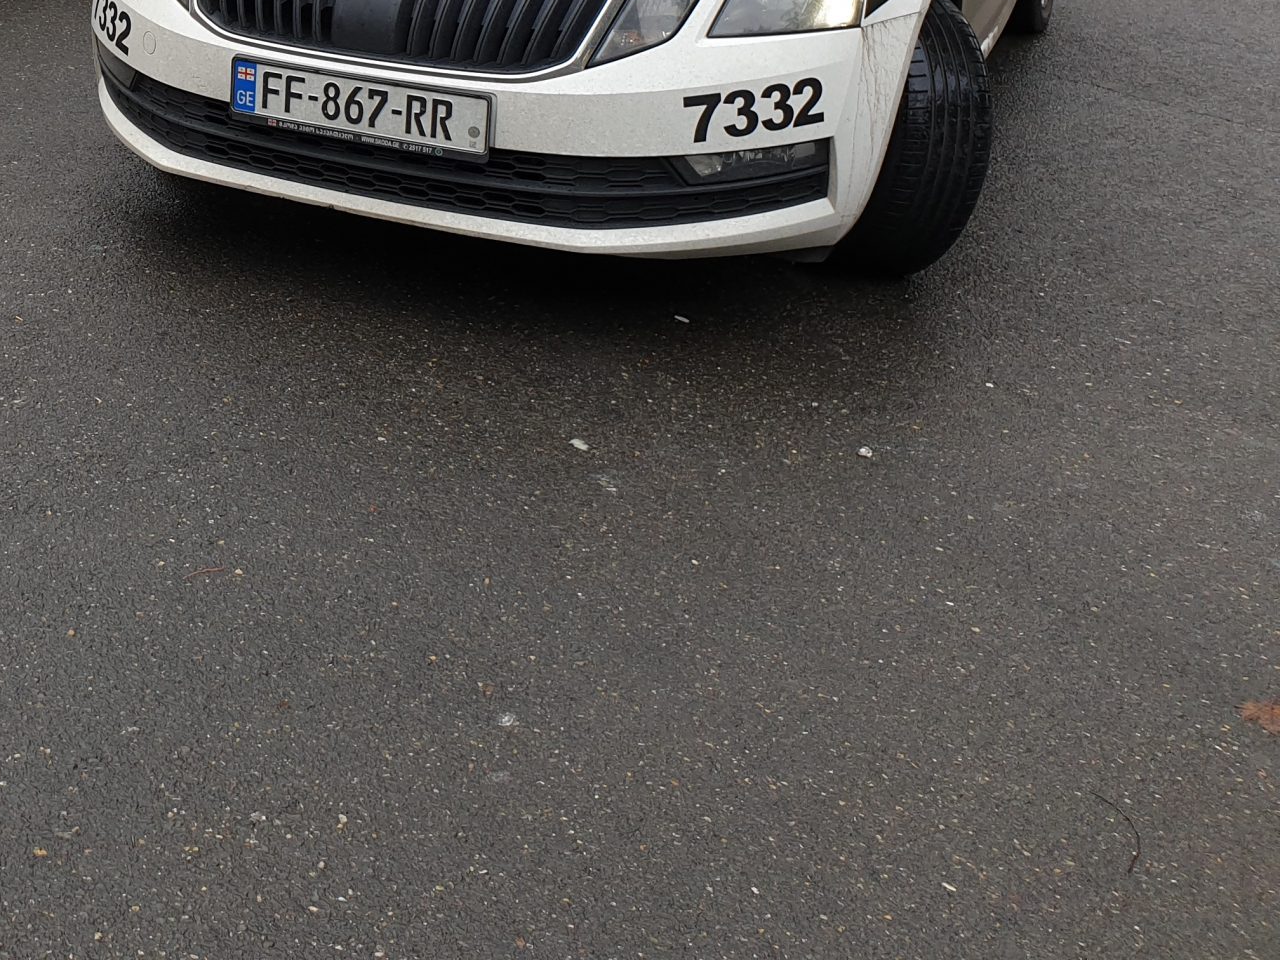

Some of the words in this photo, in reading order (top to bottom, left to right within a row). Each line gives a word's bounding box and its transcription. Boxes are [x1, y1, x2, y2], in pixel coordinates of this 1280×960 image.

[236, 89, 254, 107] GE
[261, 71, 453, 141] FF-867-RR
[683, 77, 825, 143] 7332
